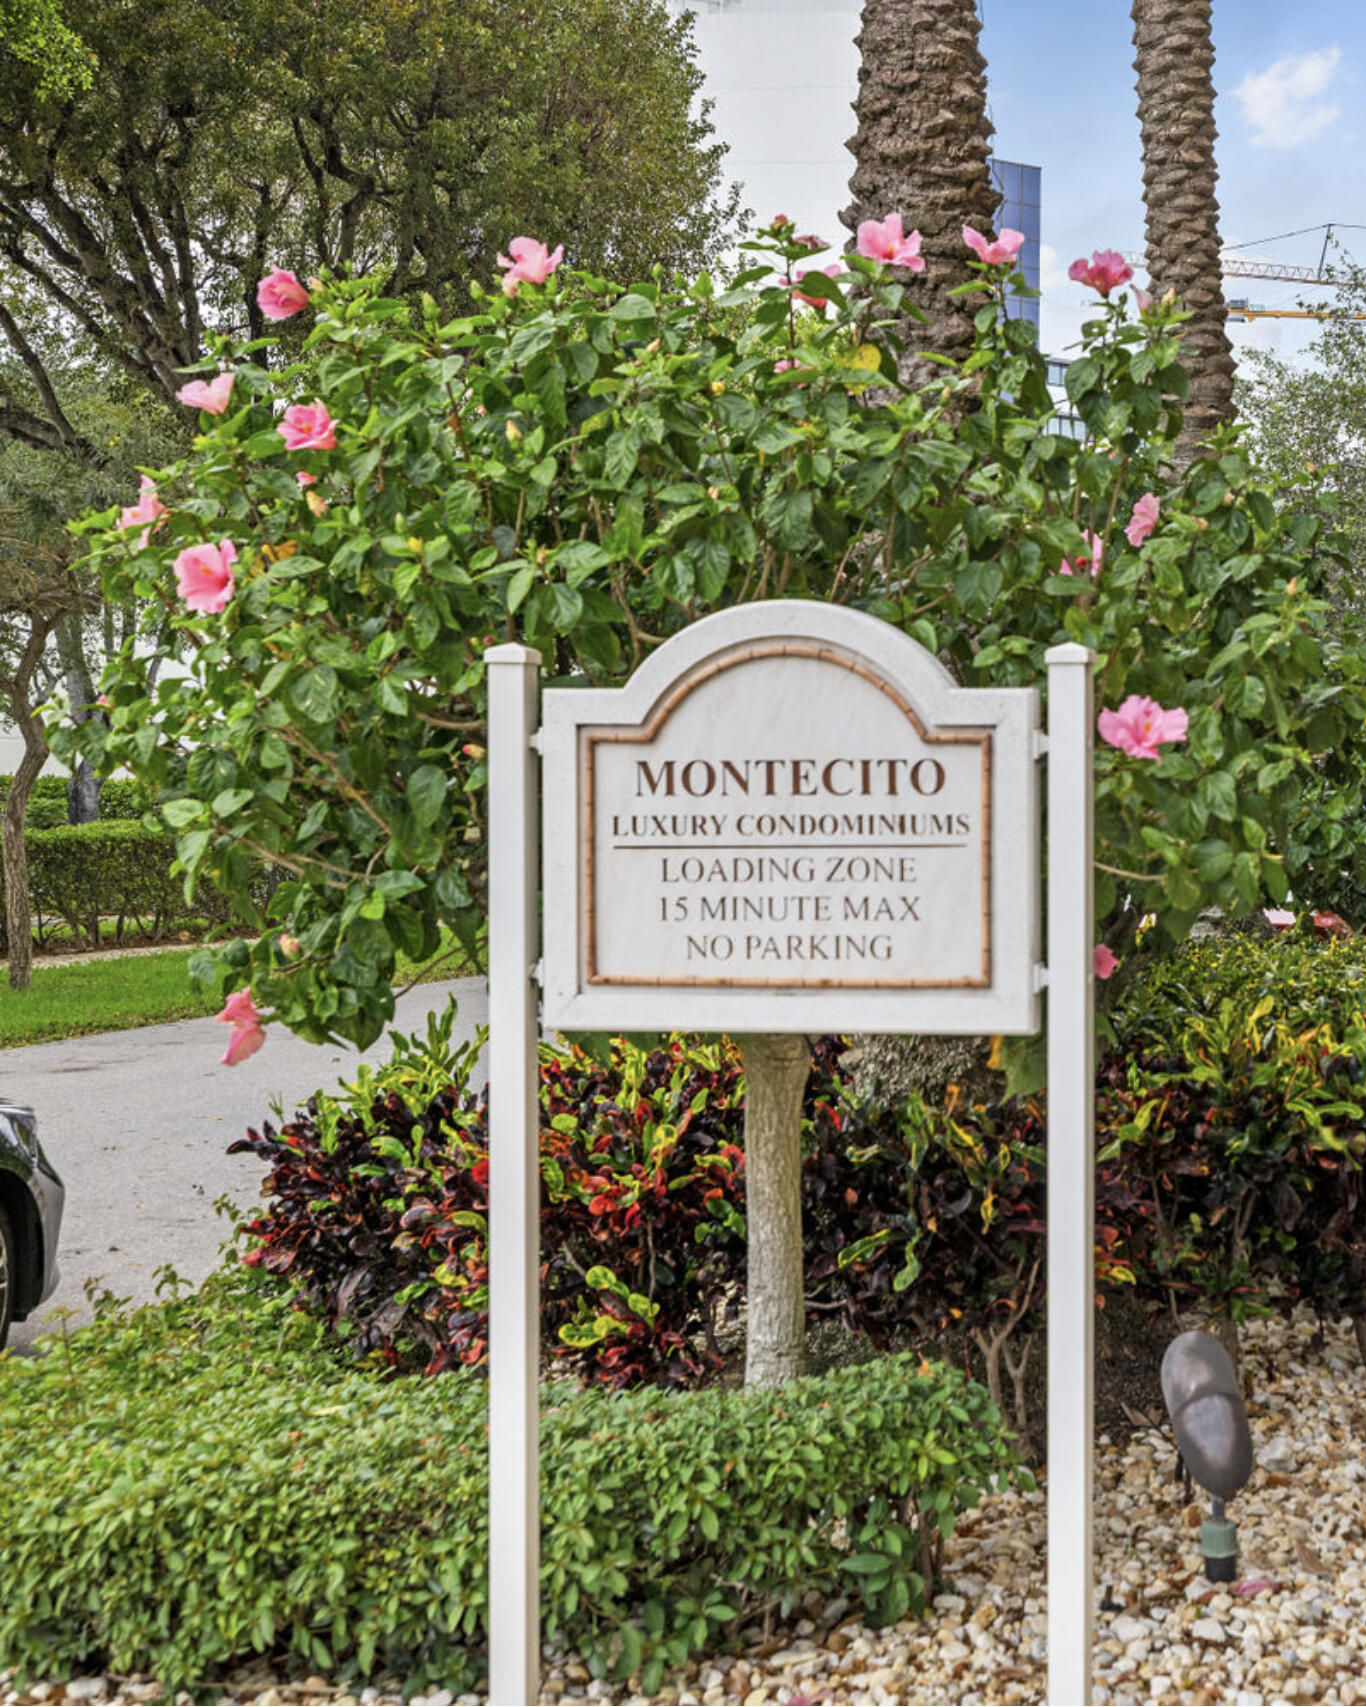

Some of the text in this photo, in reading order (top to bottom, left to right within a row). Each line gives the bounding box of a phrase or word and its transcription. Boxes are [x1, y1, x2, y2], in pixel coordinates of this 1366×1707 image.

[635, 758, 946, 797] MONTECITO
[612, 813, 971, 837] LUXURY CONDOMINIUMS
[661, 857, 917, 883] LOADING ZONE
[660, 896, 921, 922] 15 MINUTE MAX
[686, 935, 893, 960] NO PARKING
